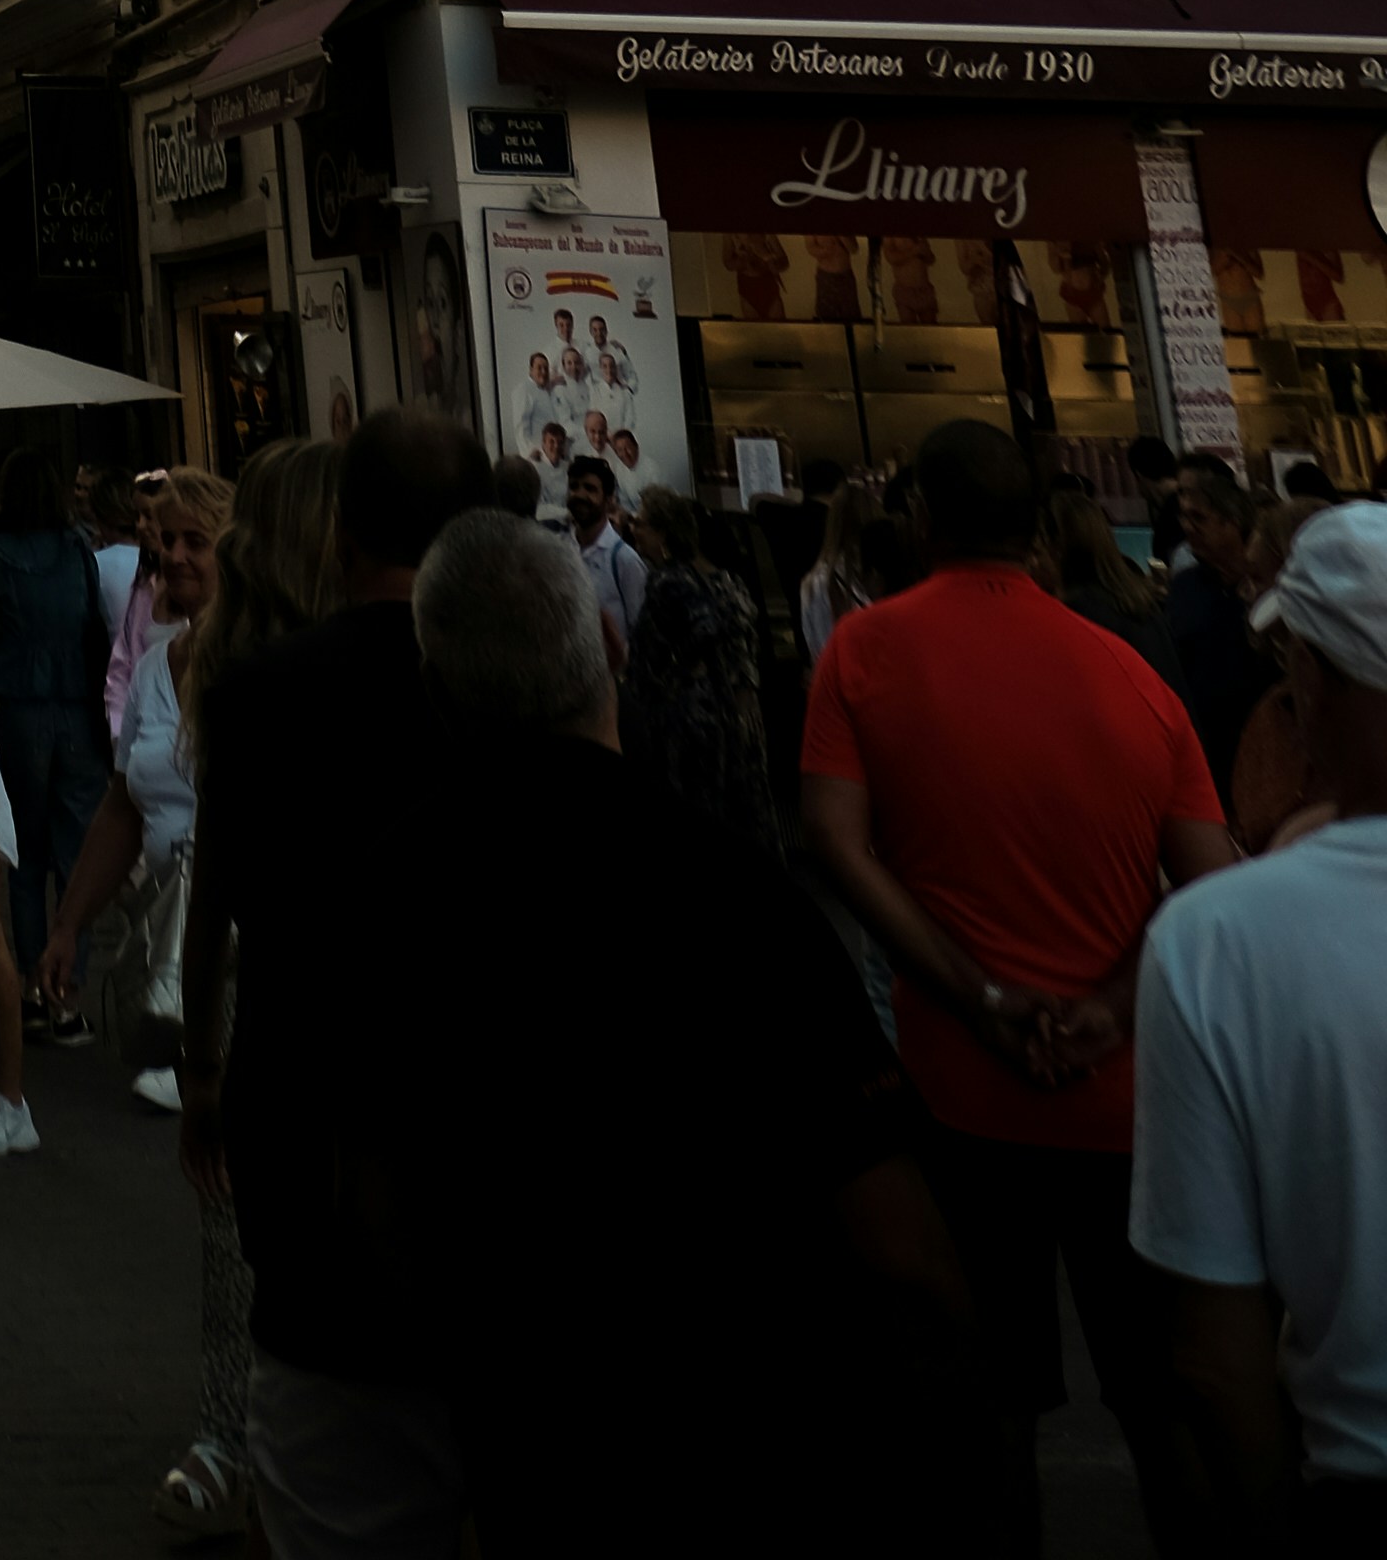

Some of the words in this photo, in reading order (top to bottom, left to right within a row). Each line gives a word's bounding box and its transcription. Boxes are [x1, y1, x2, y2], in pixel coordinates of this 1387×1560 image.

[616, 35, 755, 83] Gelateries
[770, 40, 904, 79] Artesanes
[926, 45, 1010, 82] Desde
[1022, 50, 1095, 85] 1930
[1209, 53, 1346, 100] Gelateries
[505, 135, 519, 147] DE
[522, 136, 536, 148] LA
[507, 118, 545, 133] PLAÇA
[500, 151, 544, 166] REINA
[771, 117, 1028, 229] Llinares
[42, 181, 113, 217] Hotel
